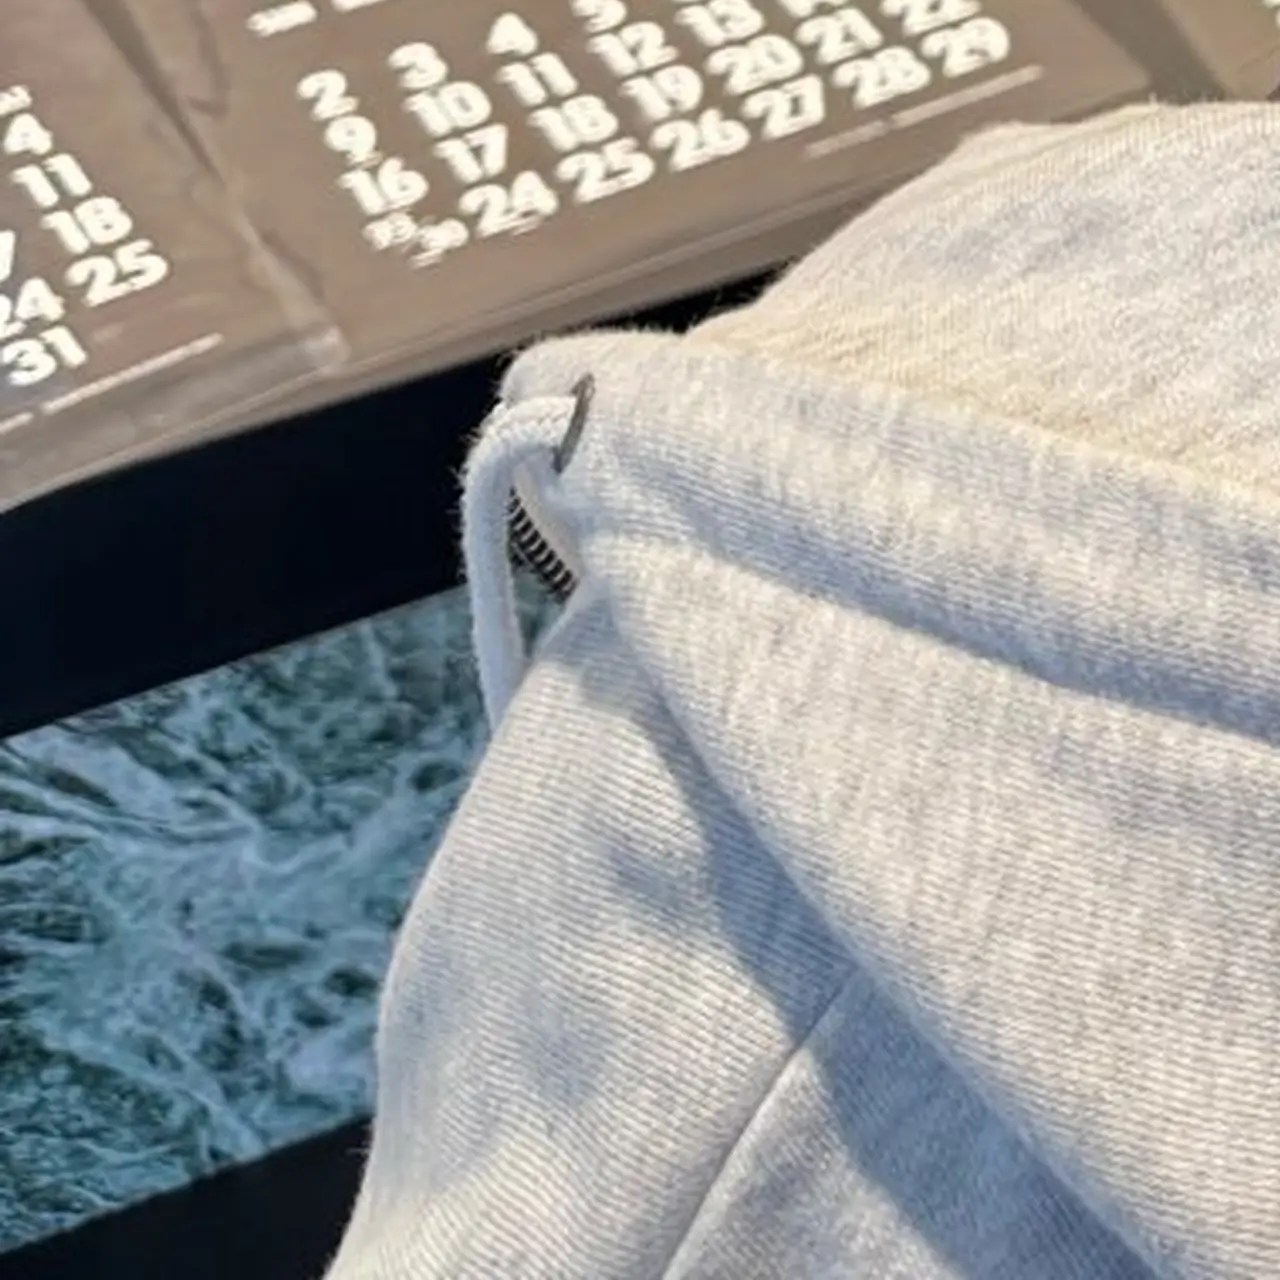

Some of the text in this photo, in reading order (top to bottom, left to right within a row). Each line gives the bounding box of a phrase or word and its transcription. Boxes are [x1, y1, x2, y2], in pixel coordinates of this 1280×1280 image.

[297, 69, 359, 121] 2
[388, 42, 448, 89] 3
[485, 12, 538, 57] 4
[324, 114, 378, 170] 9
[402, 81, 492, 138] 10
[494, 51, 578, 107] 11
[586, 21, 680, 77] 12
[4, 113, 53, 156] 4
[336, 157, 429, 216] 16
[431, 122, 508, 185] 17
[526, 94, 619, 153] 18
[619, 64, 704, 122] 19
[704, 34, 804, 96] 20
[794, 7, 884, 66] 21
[458, 170, 560, 239] 24
[556, 136, 656, 205] 25
[651, 108, 750, 174] 26
[741, 72, 825, 142] 27
[832, 46, 932, 111] 28
[921, 16, 1010, 78] 29
[9, 152, 93, 209] 11
[41, 196, 133, 255] 18
[64, 238, 169, 308] 25
[0, 325, 88, 386] 31
